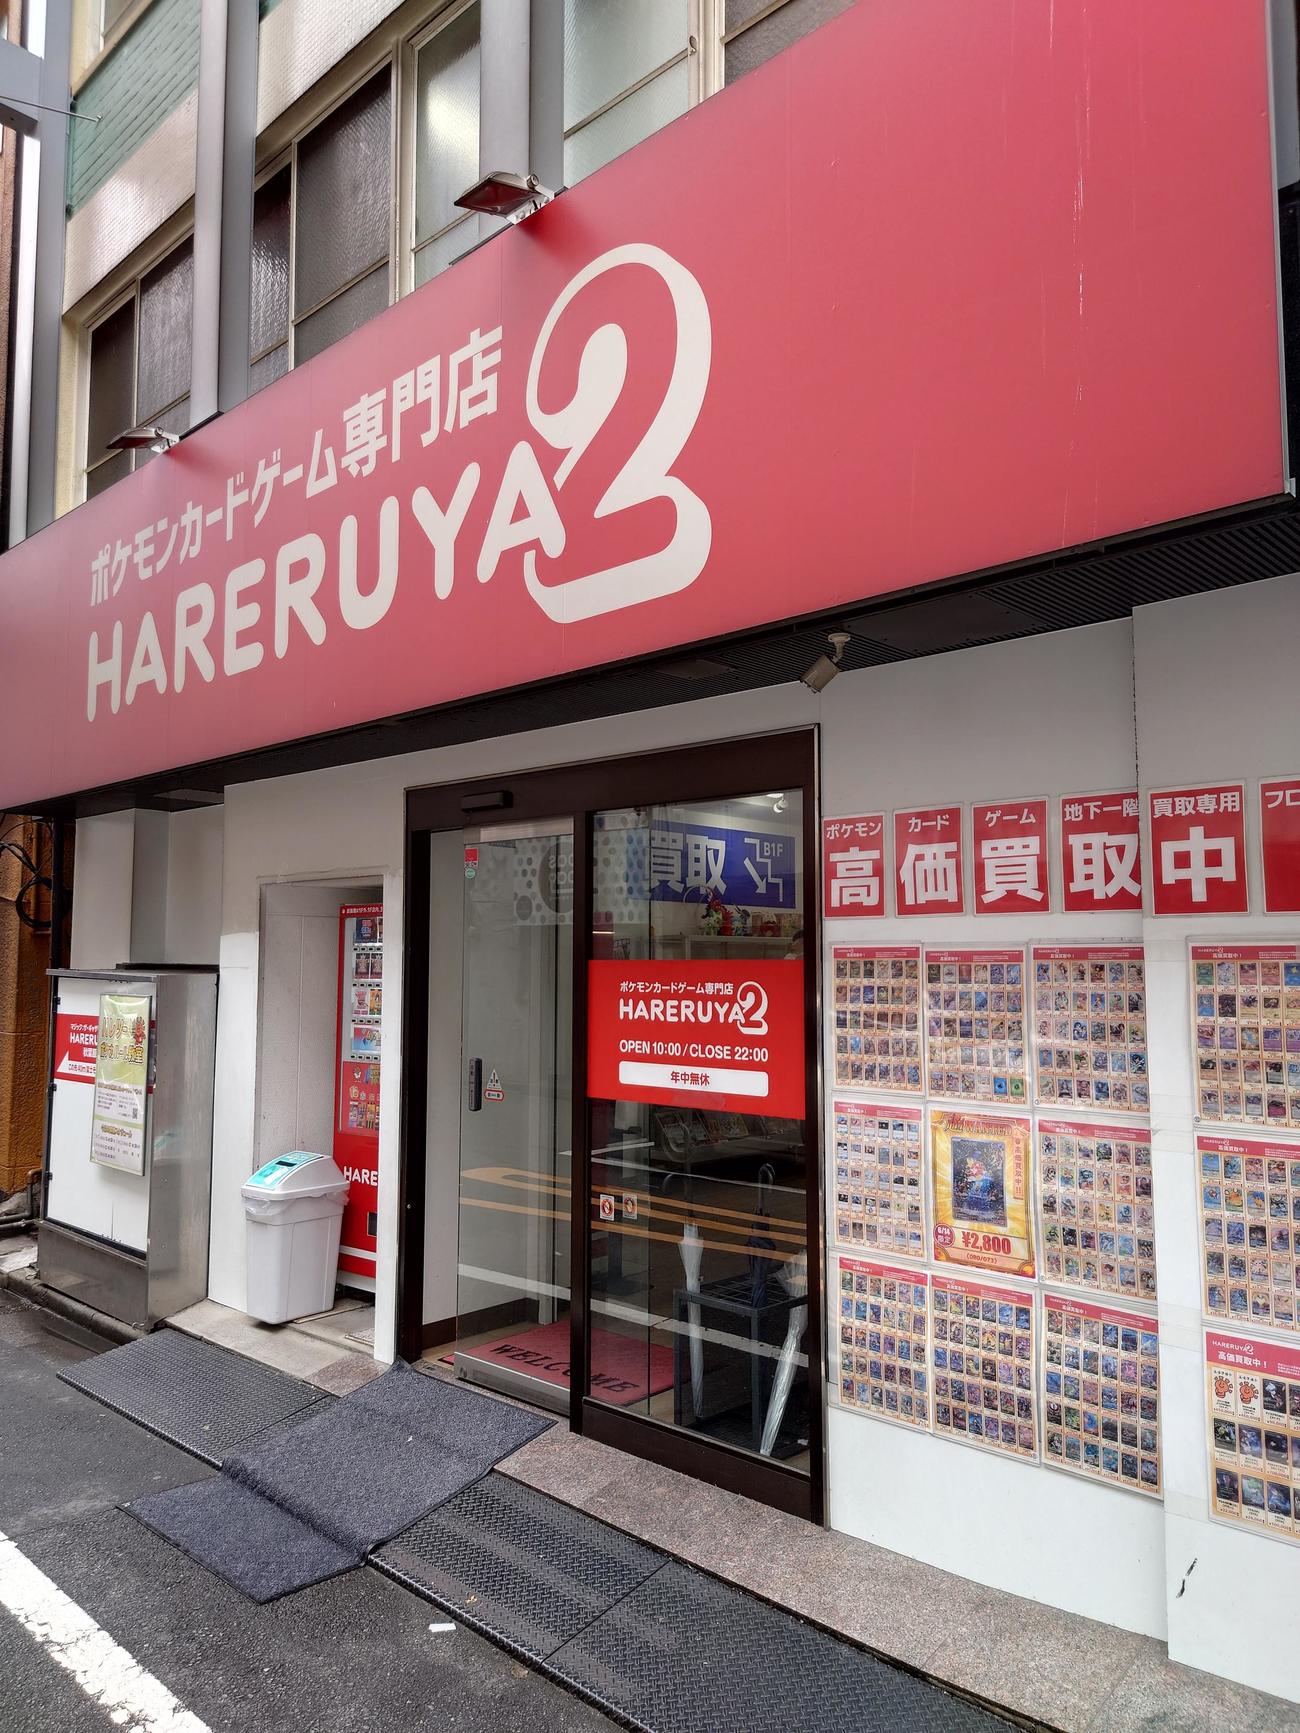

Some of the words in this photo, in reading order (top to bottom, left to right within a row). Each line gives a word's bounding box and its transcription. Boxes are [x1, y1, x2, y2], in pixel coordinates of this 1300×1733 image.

[90, 325, 502, 607] ポケモンカードゲーム専門店
[826, 822, 882, 840] ポケモン
[908, 814, 949, 833] カード
[985, 808, 1036, 827] ゲーム
[1064, 797, 1140, 822] 地下一階
[1153, 792, 1240, 818] 買取専用
[645, 830, 727, 895] 買取
[763, 842, 784, 857] B1F
[620, 981, 734, 995] ポケモンカードゲーム専門店
[619, 1040, 650, 1055] OPEN
[653, 1042, 681, 1056] 10:00
[690, 1044, 731, 1059] CLOSE
[734, 1047, 768, 1062] 22:00
[671, 1071, 710, 1086] 年中無休
[962, 1231, 1011, 1255] ¥2,800
